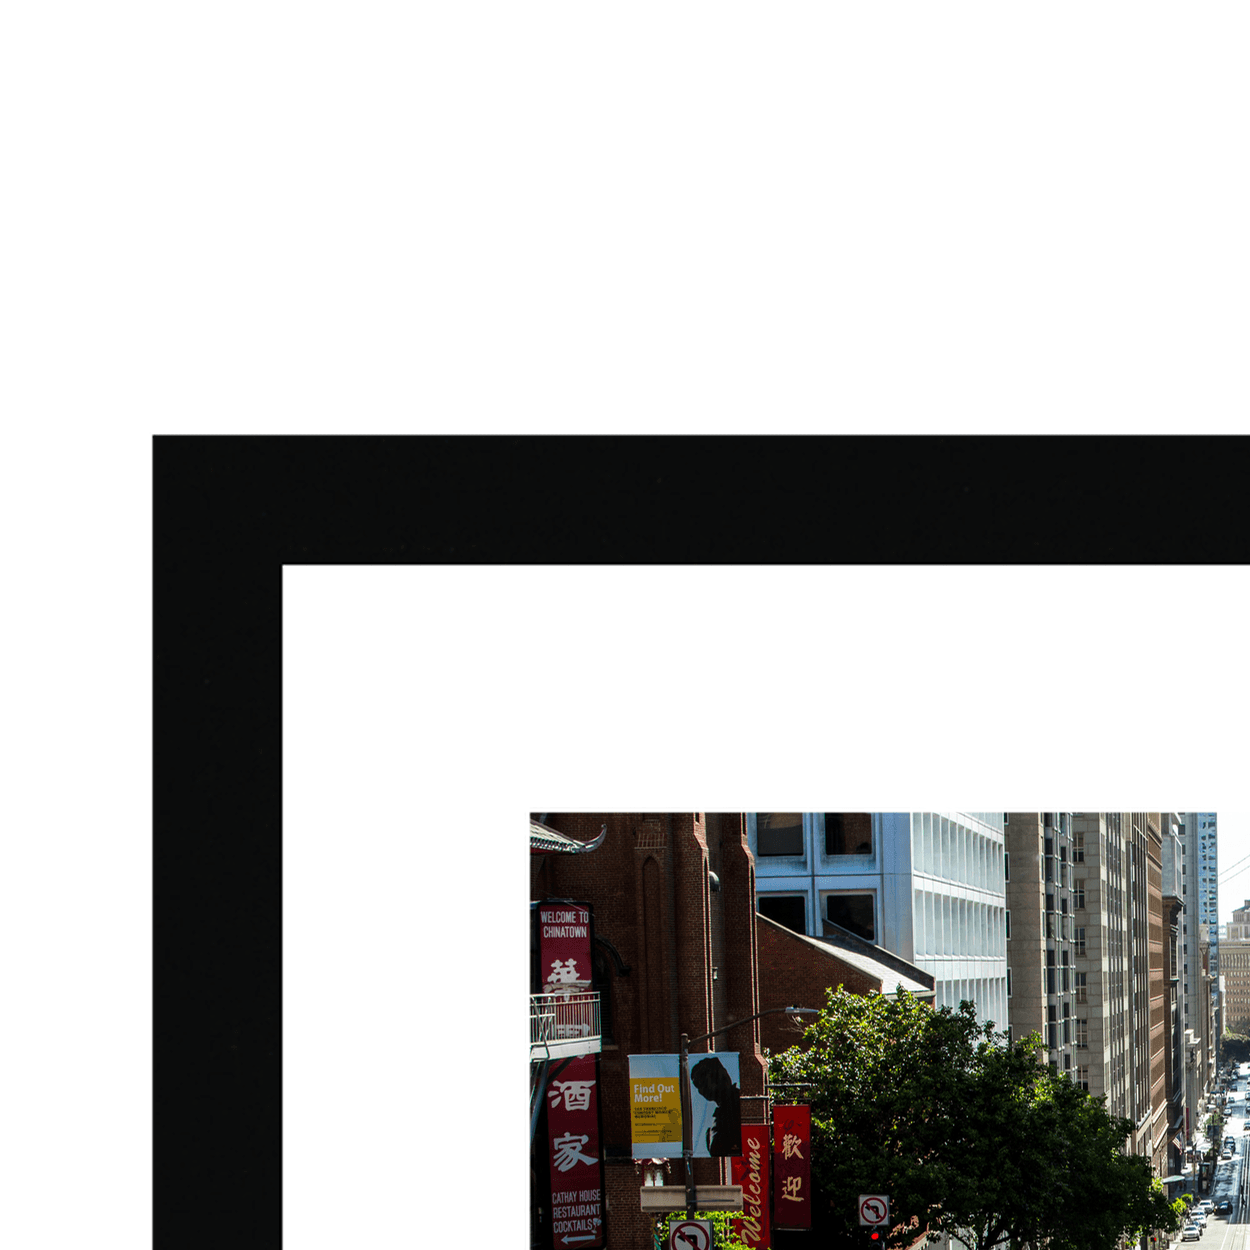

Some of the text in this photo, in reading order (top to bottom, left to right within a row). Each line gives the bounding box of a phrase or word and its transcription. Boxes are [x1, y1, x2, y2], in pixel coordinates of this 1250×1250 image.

[540, 911, 589, 924] WELCOME TO
[543, 926, 587, 938] CHINATOWN
[634, 1083, 675, 1094] Find Out
[634, 1093, 663, 1103] More!
[781, 1133, 804, 1202] 歡迎
[552, 1188, 601, 1204] CATHAY HOUSE
[741, 1137, 762, 1244] Welcome
[553, 1203, 601, 1219] RESTAURANT
[553, 1218, 593, 1233] COCKTAILS
